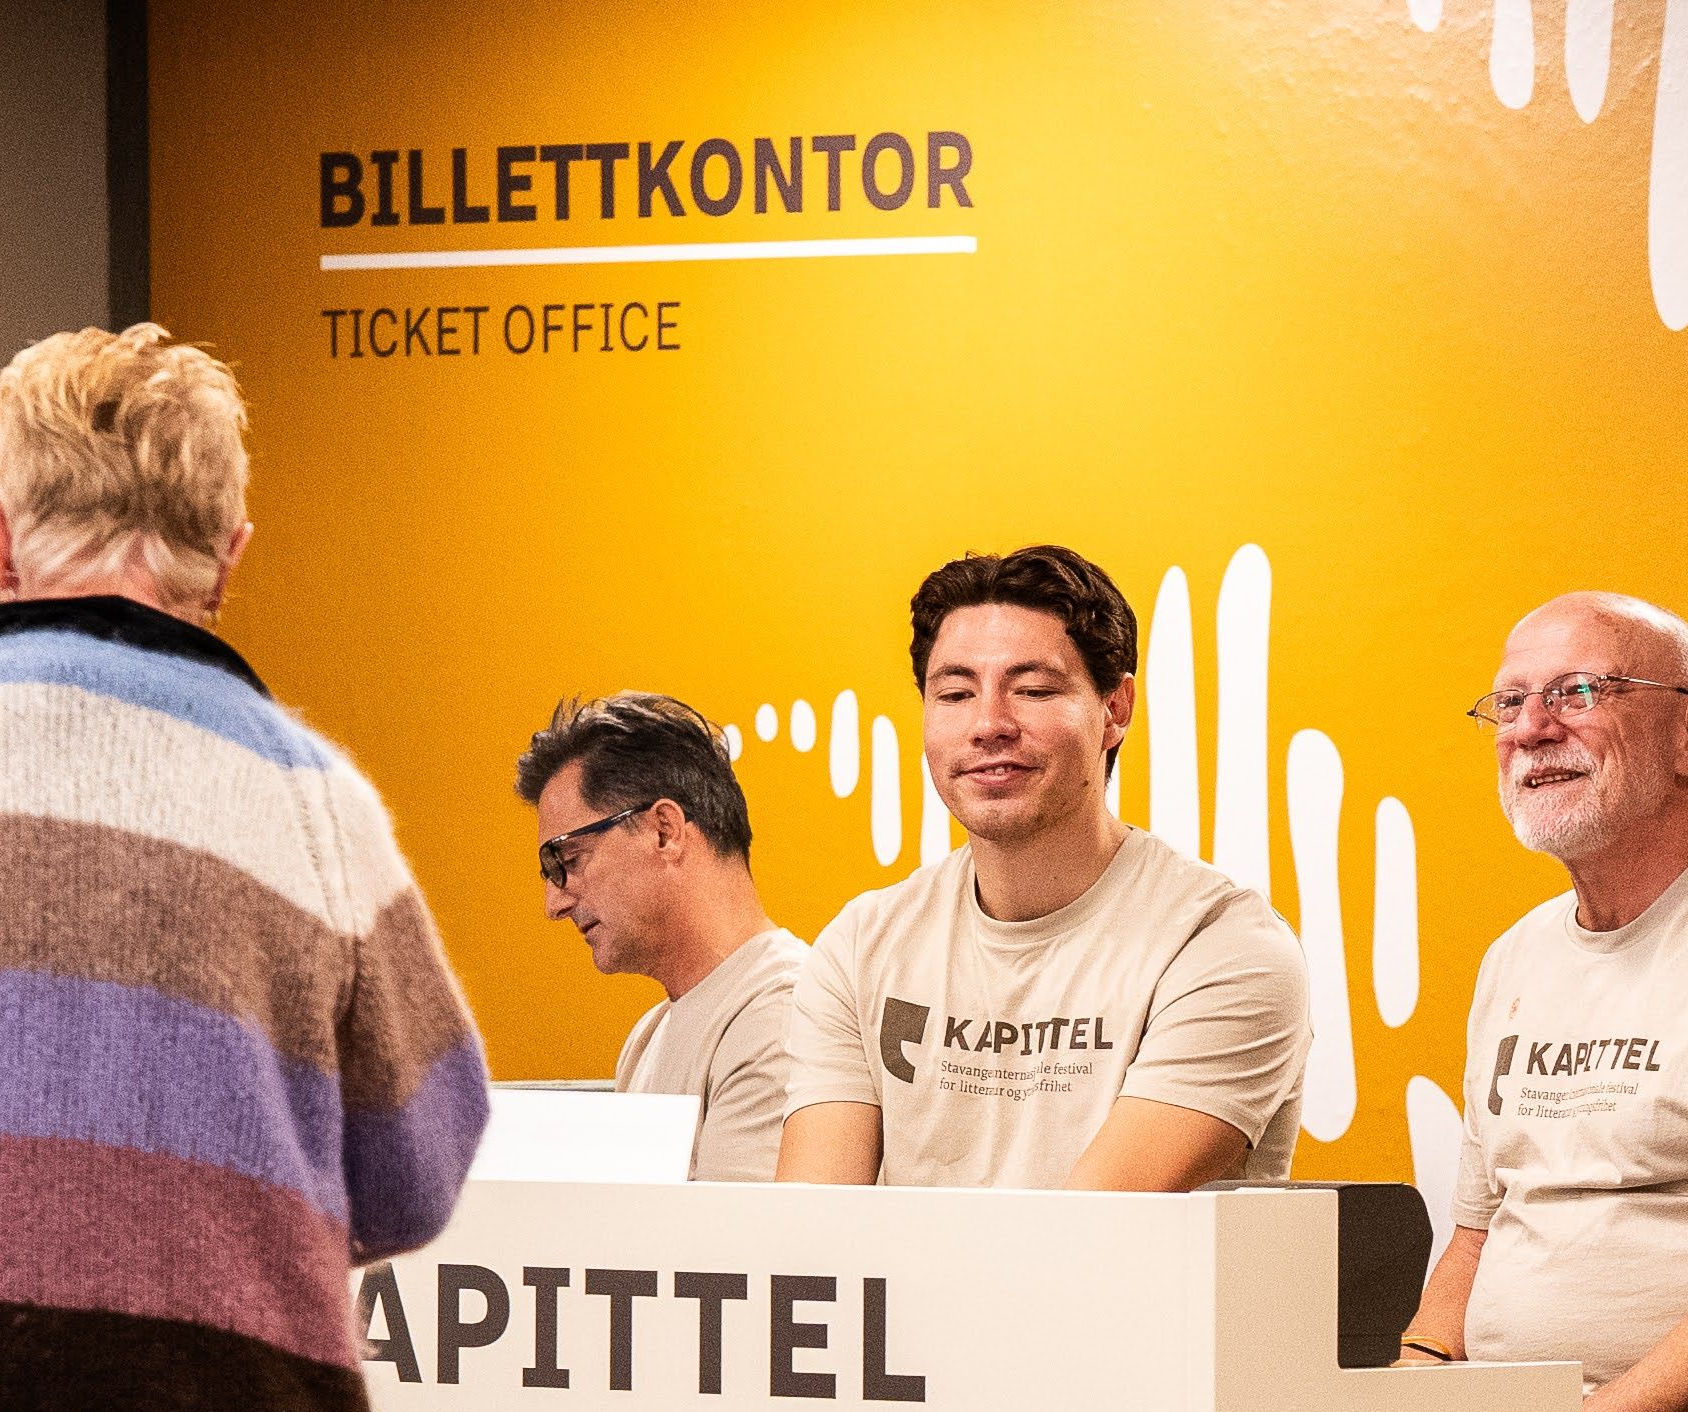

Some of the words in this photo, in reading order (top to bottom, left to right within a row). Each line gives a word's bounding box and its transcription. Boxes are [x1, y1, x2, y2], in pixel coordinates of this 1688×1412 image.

[319, 131, 975, 229] BILLETTKONTOR
[321, 306, 490, 359] TICKET
[503, 301, 681, 356] OFFICE
[943, 1016, 1114, 1056] KAPITTEL
[1053, 1061, 1093, 1075] festival
[1526, 1038, 1661, 1076] KAPITTEL
[939, 1077, 956, 1091] for
[1006, 1087, 1022, 1101] og
[1517, 1103, 1535, 1116] for
[357, 1261, 926, 1403] APITTEL
